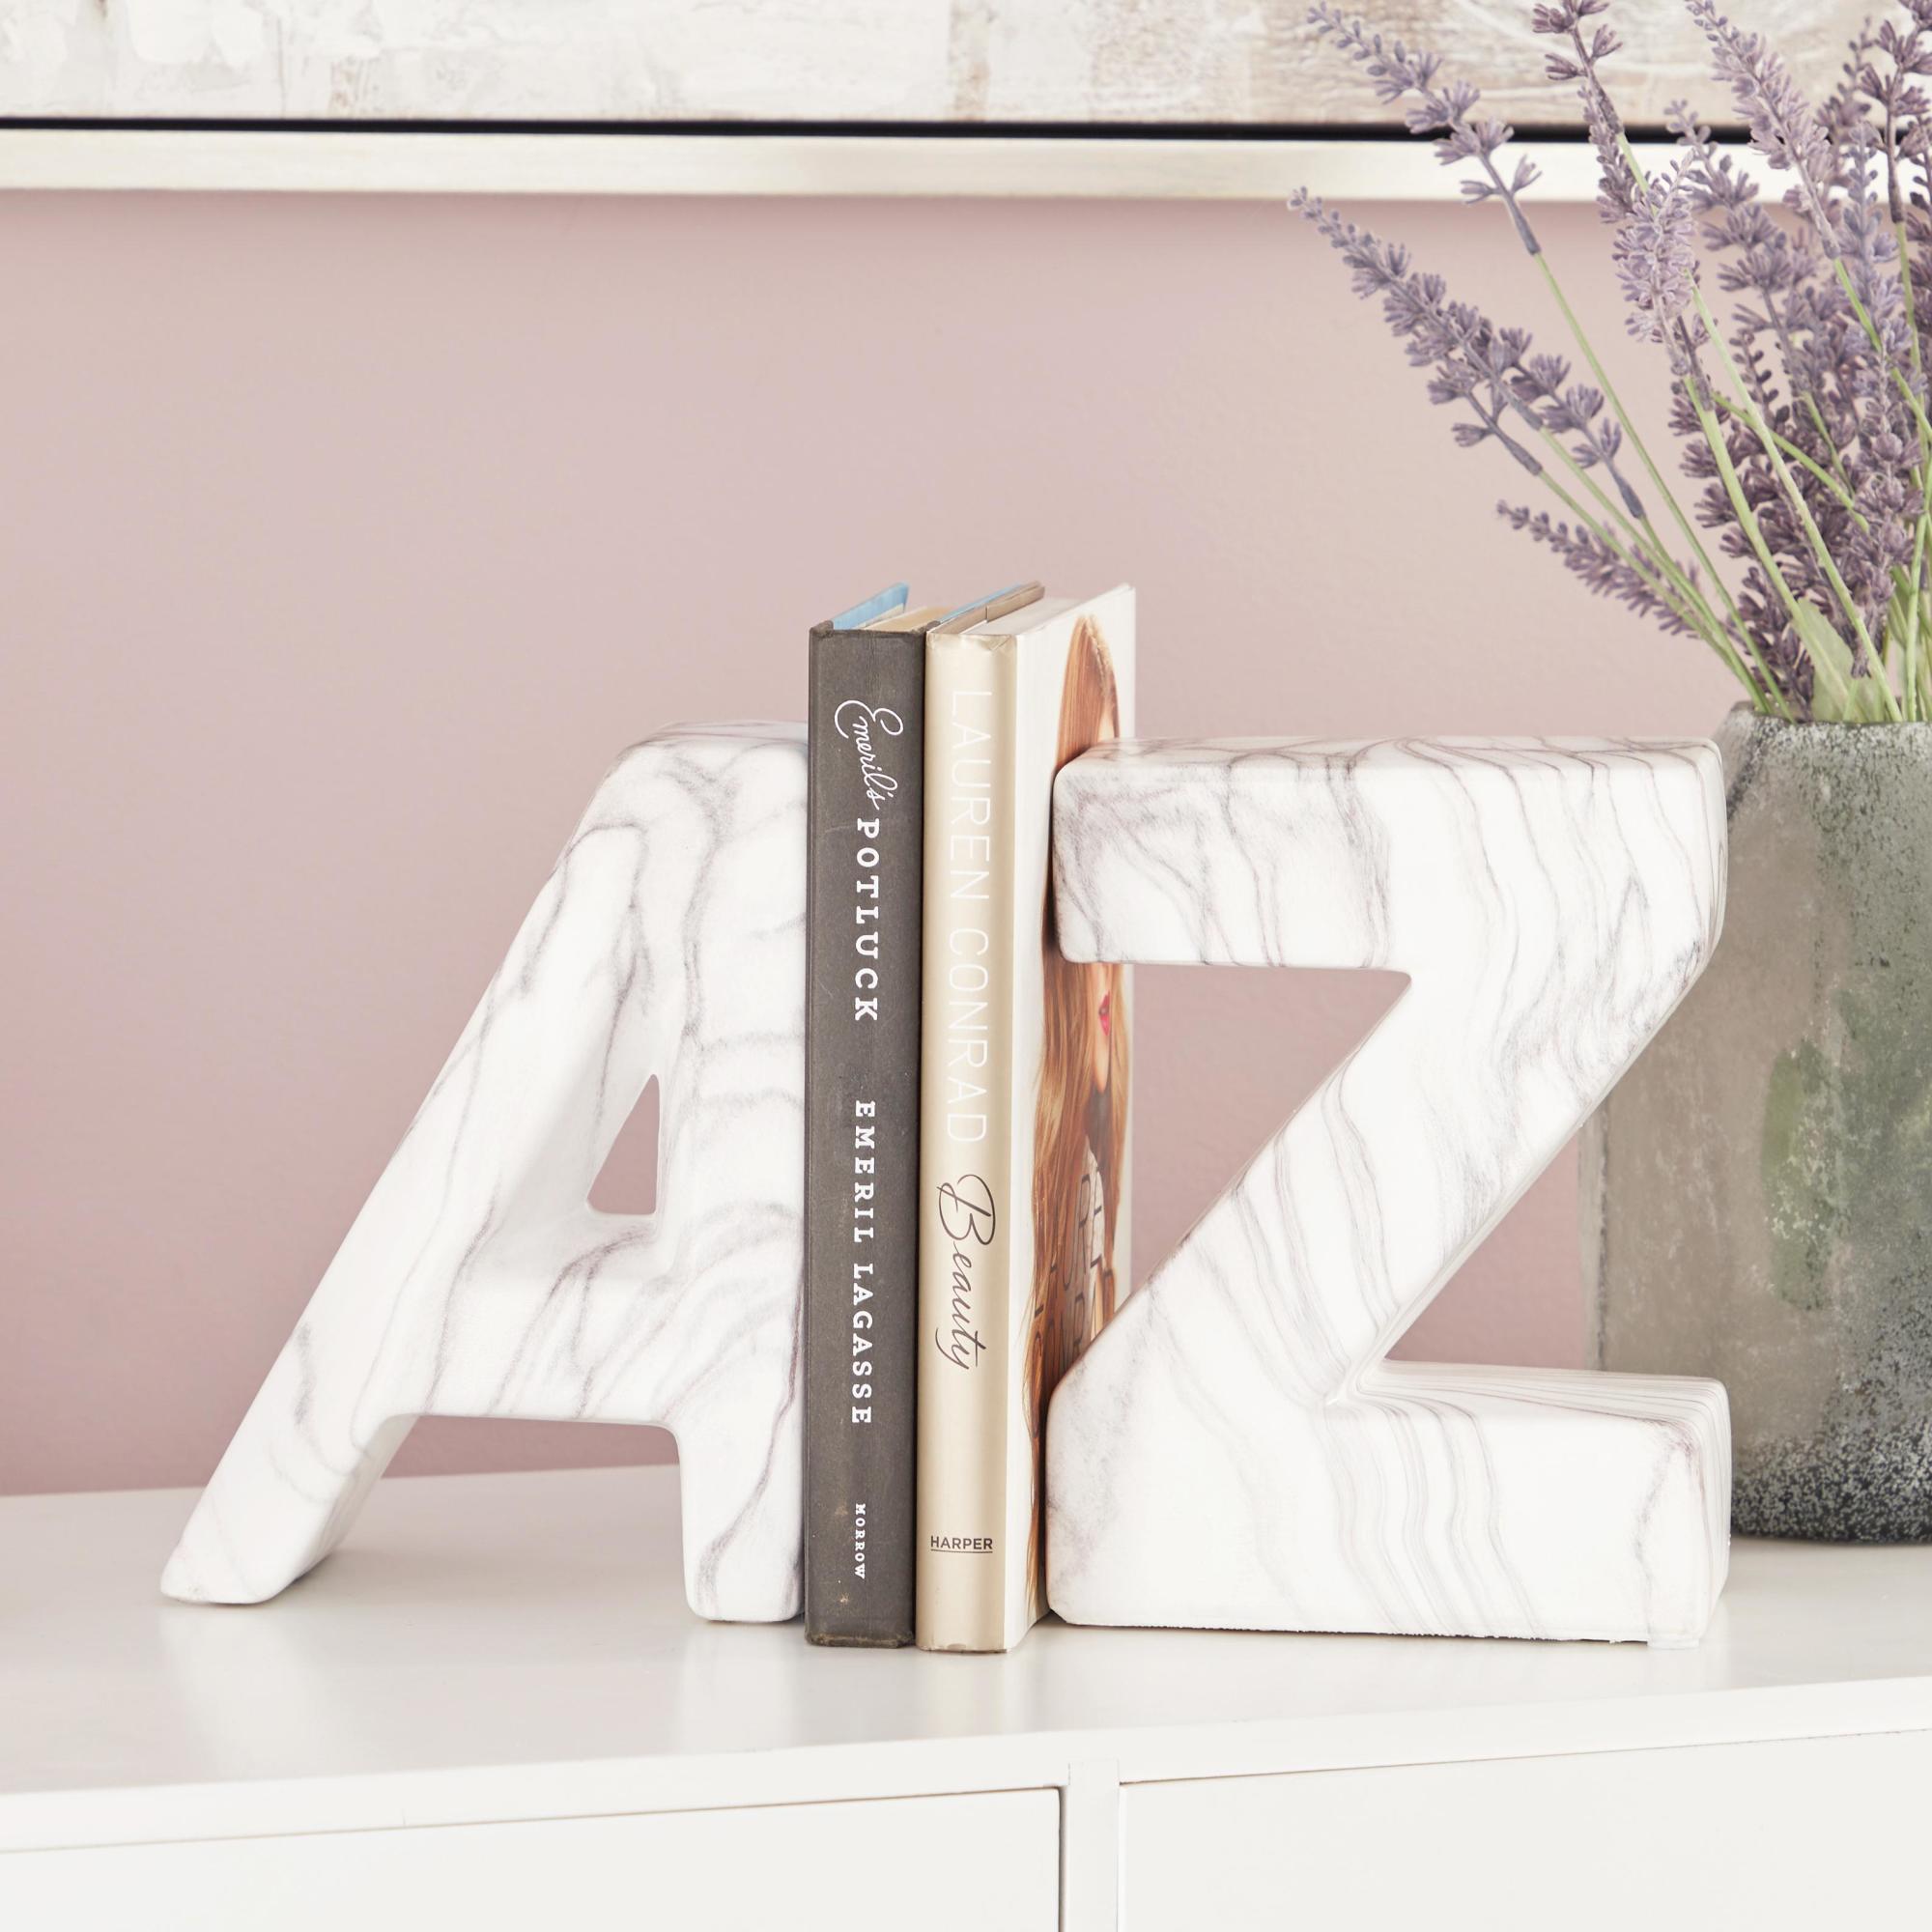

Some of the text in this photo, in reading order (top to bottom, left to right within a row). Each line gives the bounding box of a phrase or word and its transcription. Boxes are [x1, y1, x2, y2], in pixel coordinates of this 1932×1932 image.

[834, 698, 904, 1021] Emeril's POTLUCK
[947, 690, 993, 1144] LAUREN CONRAD
[851, 1099, 877, 1424] EMERIL LAGASSE
[935, 1173, 997, 1371] Beauty
[854, 1502, 867, 1580] MORROW
[929, 1535, 994, 1551] HARPER
